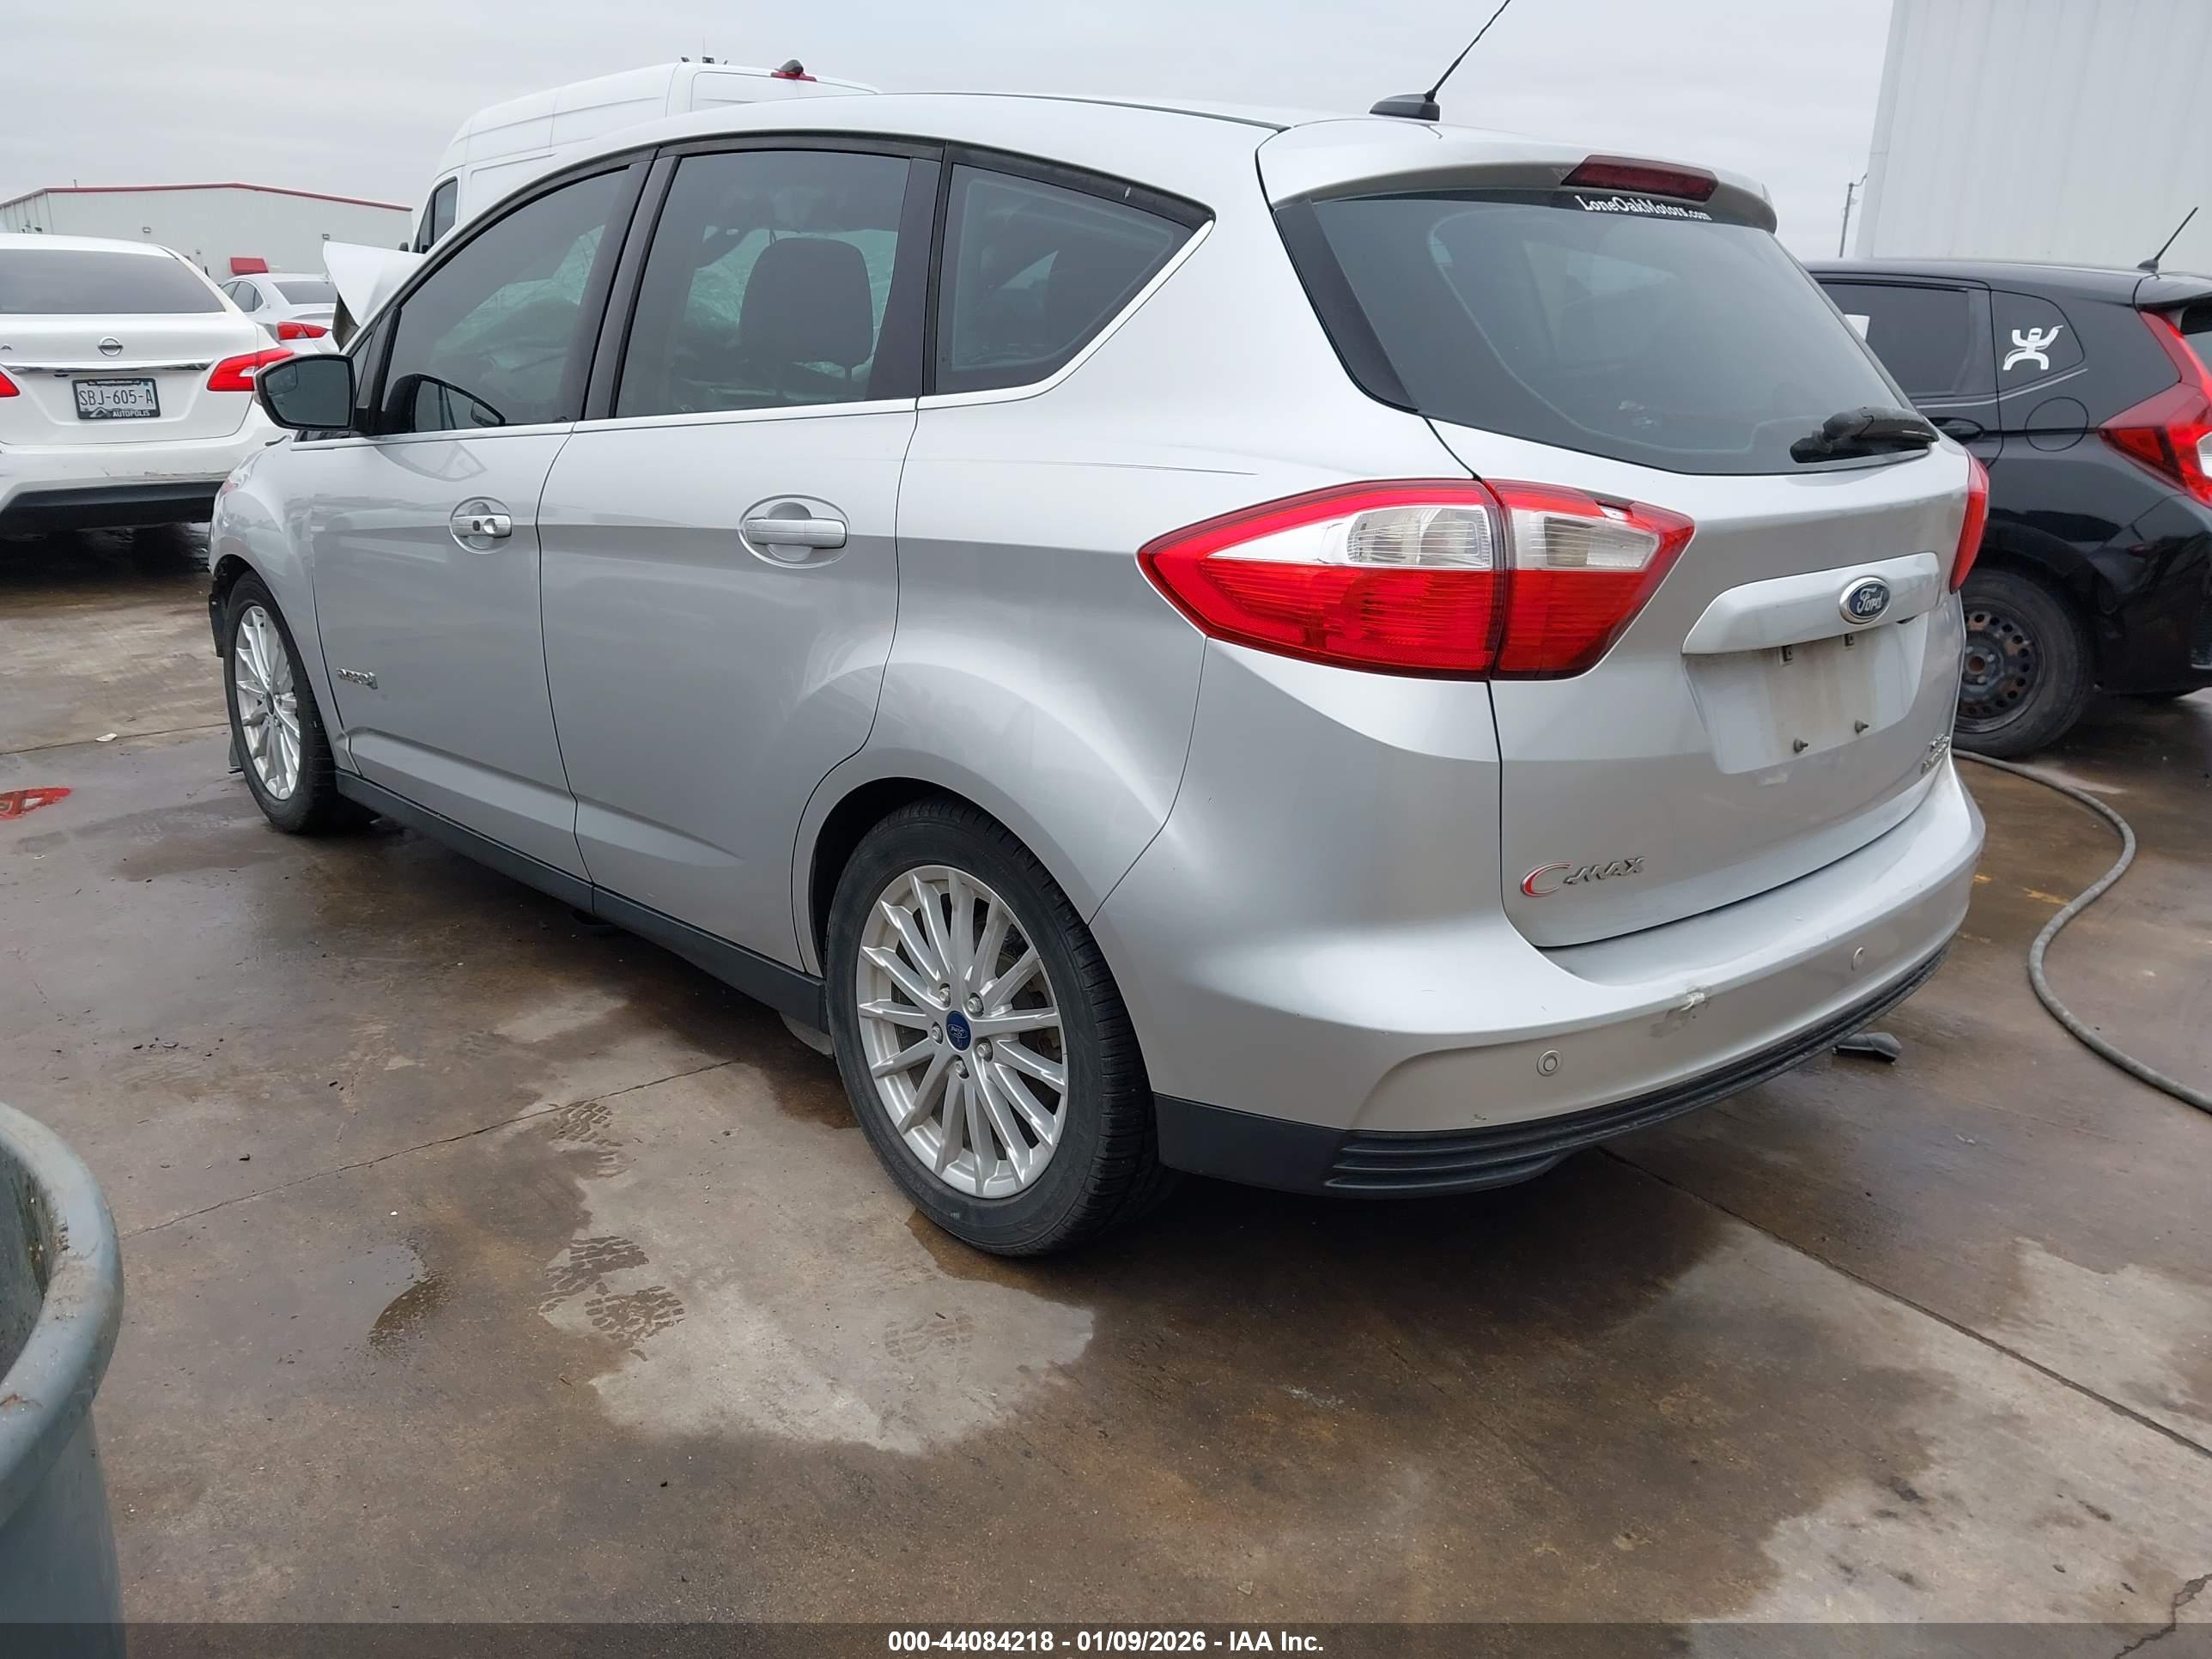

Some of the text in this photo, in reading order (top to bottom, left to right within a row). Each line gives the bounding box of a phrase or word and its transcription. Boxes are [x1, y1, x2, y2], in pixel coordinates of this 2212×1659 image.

[1575, 195, 1712, 221] LoneOakMotors.com
[79, 389, 154, 405] SBJ-605-A
[1856, 586, 1884, 614] Ford
